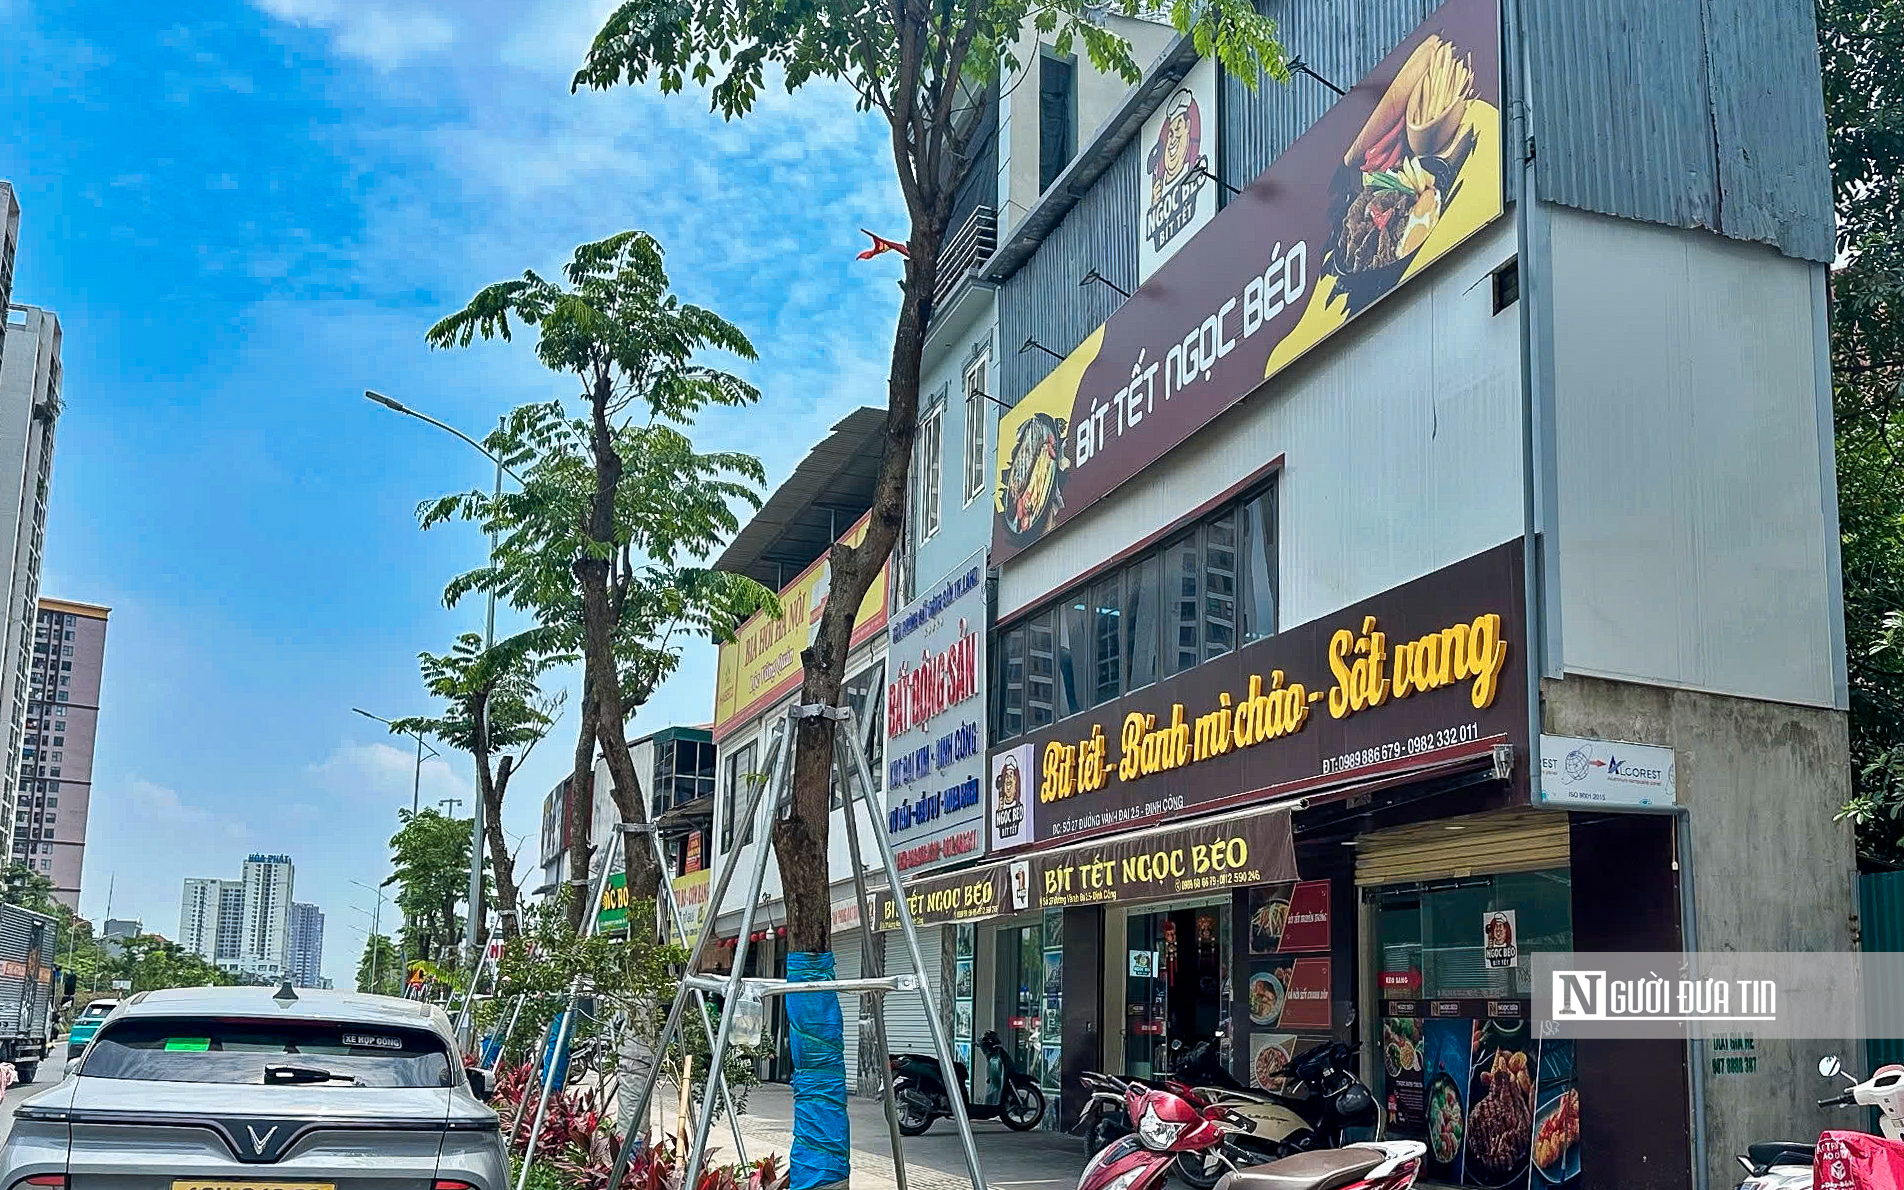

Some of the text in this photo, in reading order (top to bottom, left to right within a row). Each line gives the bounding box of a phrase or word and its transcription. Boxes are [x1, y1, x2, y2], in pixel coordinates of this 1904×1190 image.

[1147, 183, 1180, 237] NGỌC
[1159, 201, 1193, 247] BÍT TẾT
[1076, 240, 1307, 469] BÍT TẾT NGỌC BÉO
[889, 618, 978, 738] BẤT ĐỘNG SẢN
[1041, 741, 1077, 804] Bít
[1077, 724, 1107, 794] tết
[1119, 703, 1194, 782] Bánh
[1194, 692, 1234, 762] mì
[1234, 669, 1309, 749] chảo
[1329, 615, 1391, 719] Sốt
[1393, 613, 1507, 709] vang
[954, 720, 978, 761] CÔNG
[1362, 746, 1380, 766] 886
[1381, 742, 1401, 761] 679
[1407, 733, 1435, 755] 0982
[1436, 727, 1457, 748] 332
[1459, 722, 1479, 742] 011
[1608, 754, 1662, 780] ALCOREST
[997, 804, 1024, 826] NGỌC BÉO
[1062, 815, 1071, 834] SỐ
[1079, 811, 1101, 830] ĐƯỜNG
[1163, 794, 1184, 811] CÔNG
[1044, 836, 1248, 894] BÍT TẾT NGỌC BÉO
[1233, 871, 1247, 883] 590
[1247, 870, 1260, 881] 246
[927, 888, 960, 913] NGỌC
[964, 880, 993, 906] BÉO
[1486, 948, 1502, 959] NGỌC
